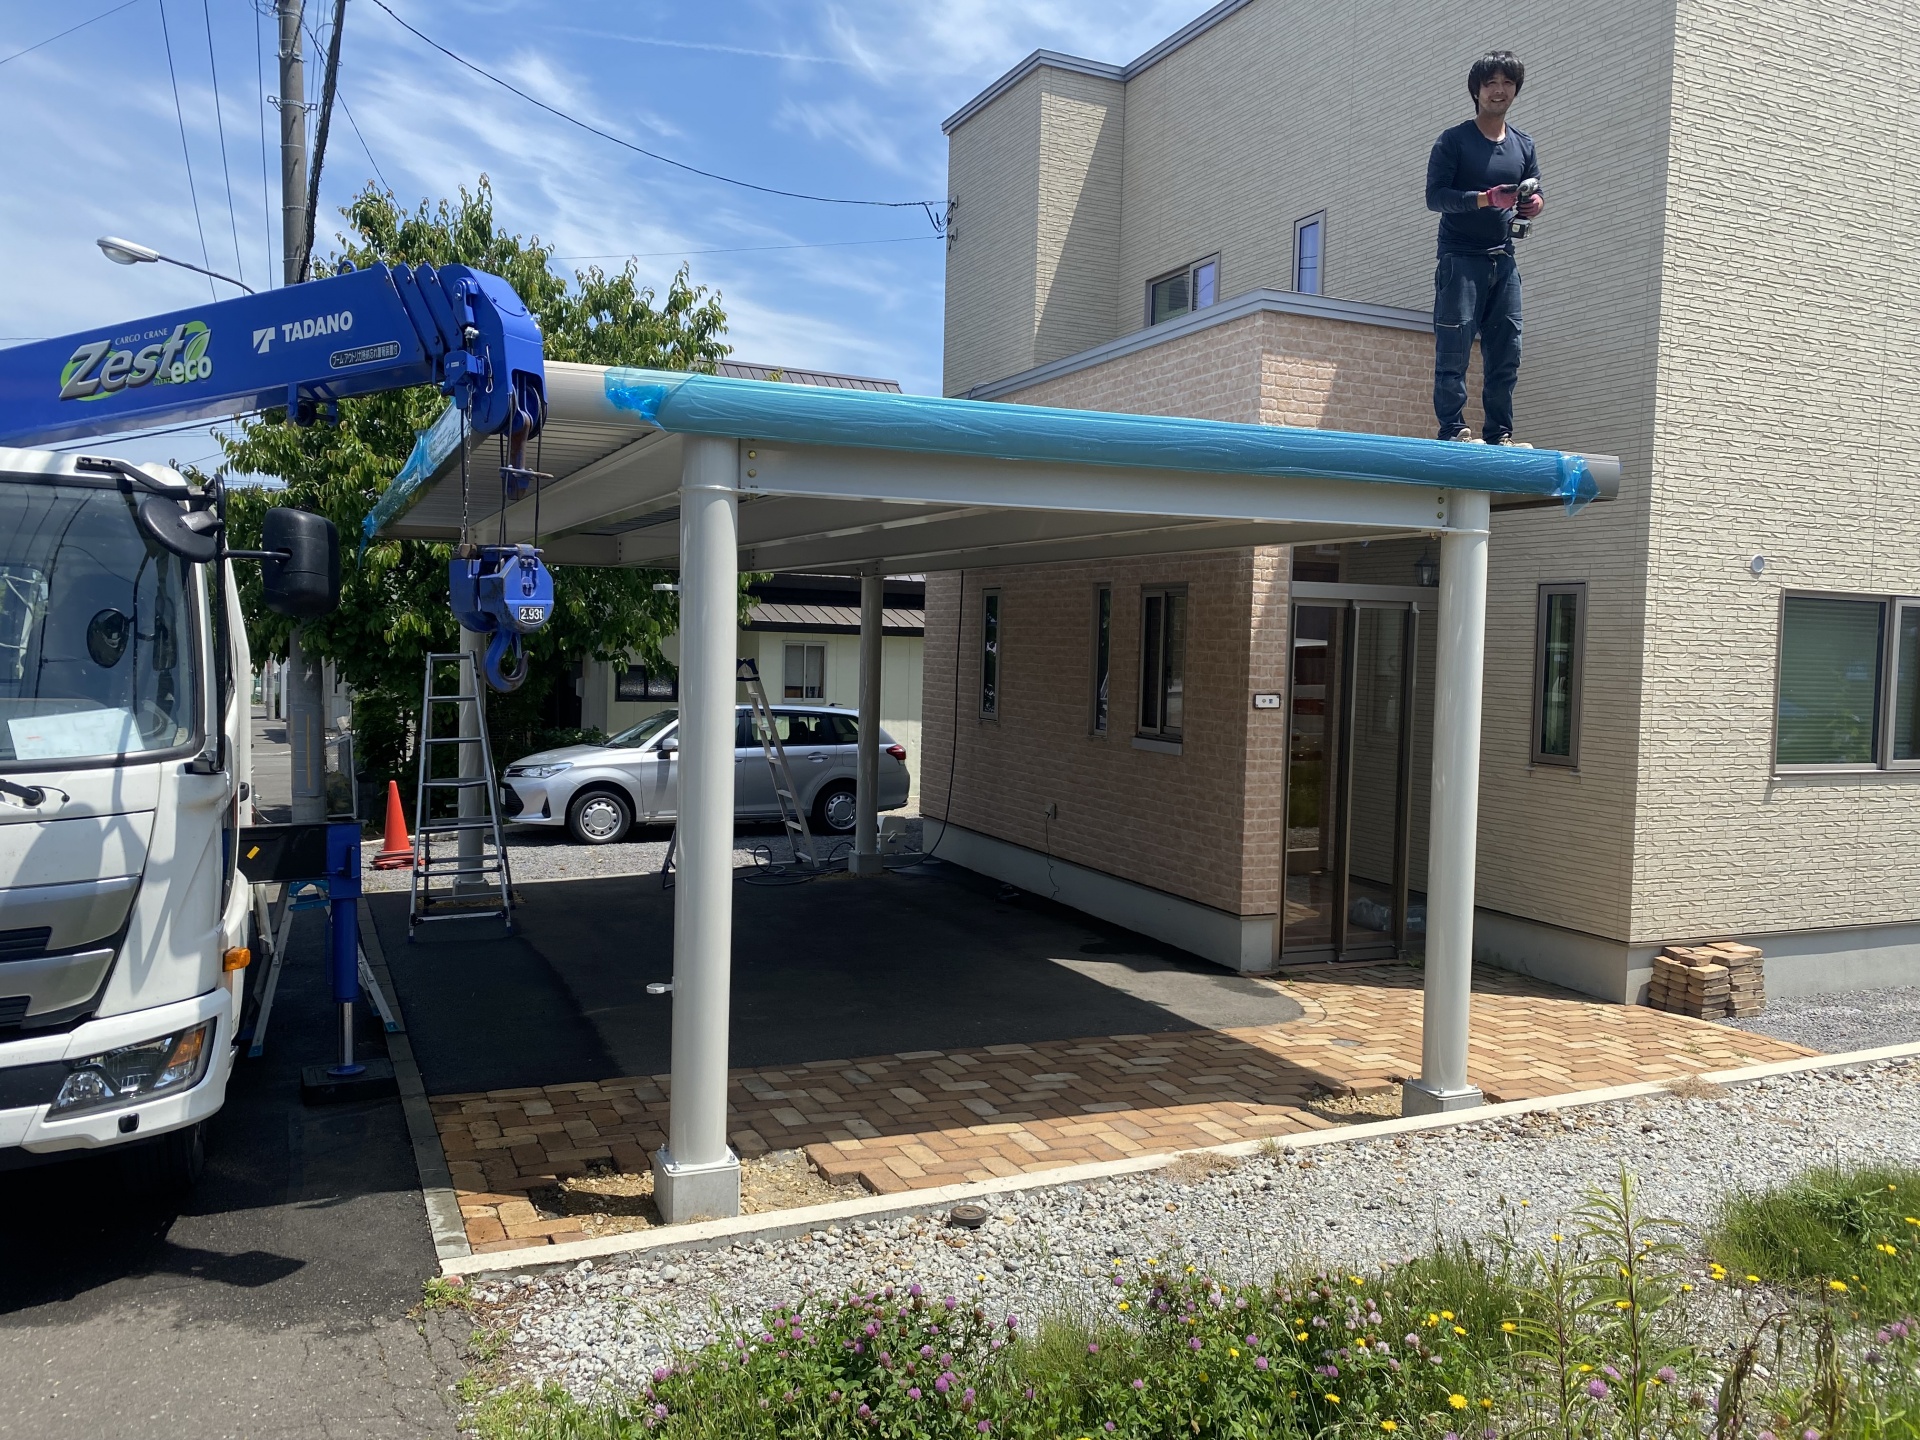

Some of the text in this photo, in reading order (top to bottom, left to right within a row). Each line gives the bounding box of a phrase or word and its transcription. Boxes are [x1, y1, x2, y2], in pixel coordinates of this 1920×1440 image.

[115, 328, 168, 346] CARGO CRANE
[282, 311, 353, 343] TADANO
[59, 324, 187, 400] Zest
[171, 356, 212, 383] eco
[520, 608, 543, 620] 2.93t
